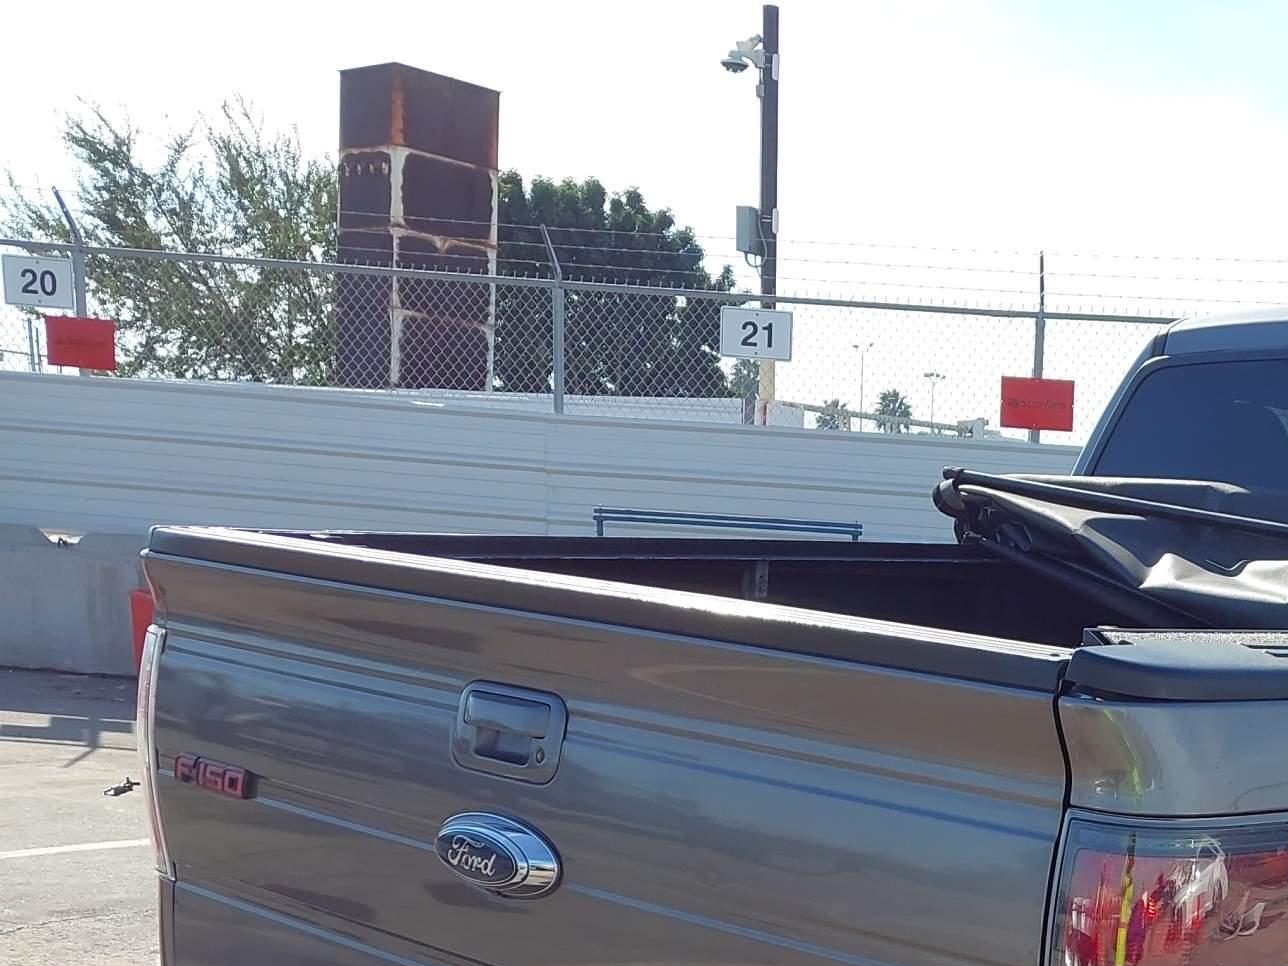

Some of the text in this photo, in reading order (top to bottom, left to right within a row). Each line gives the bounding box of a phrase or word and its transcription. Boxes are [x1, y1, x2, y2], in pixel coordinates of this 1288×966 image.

[20, 268, 57, 297] 20
[740, 320, 773, 348] 21
[447, 834, 497, 877] Ford
